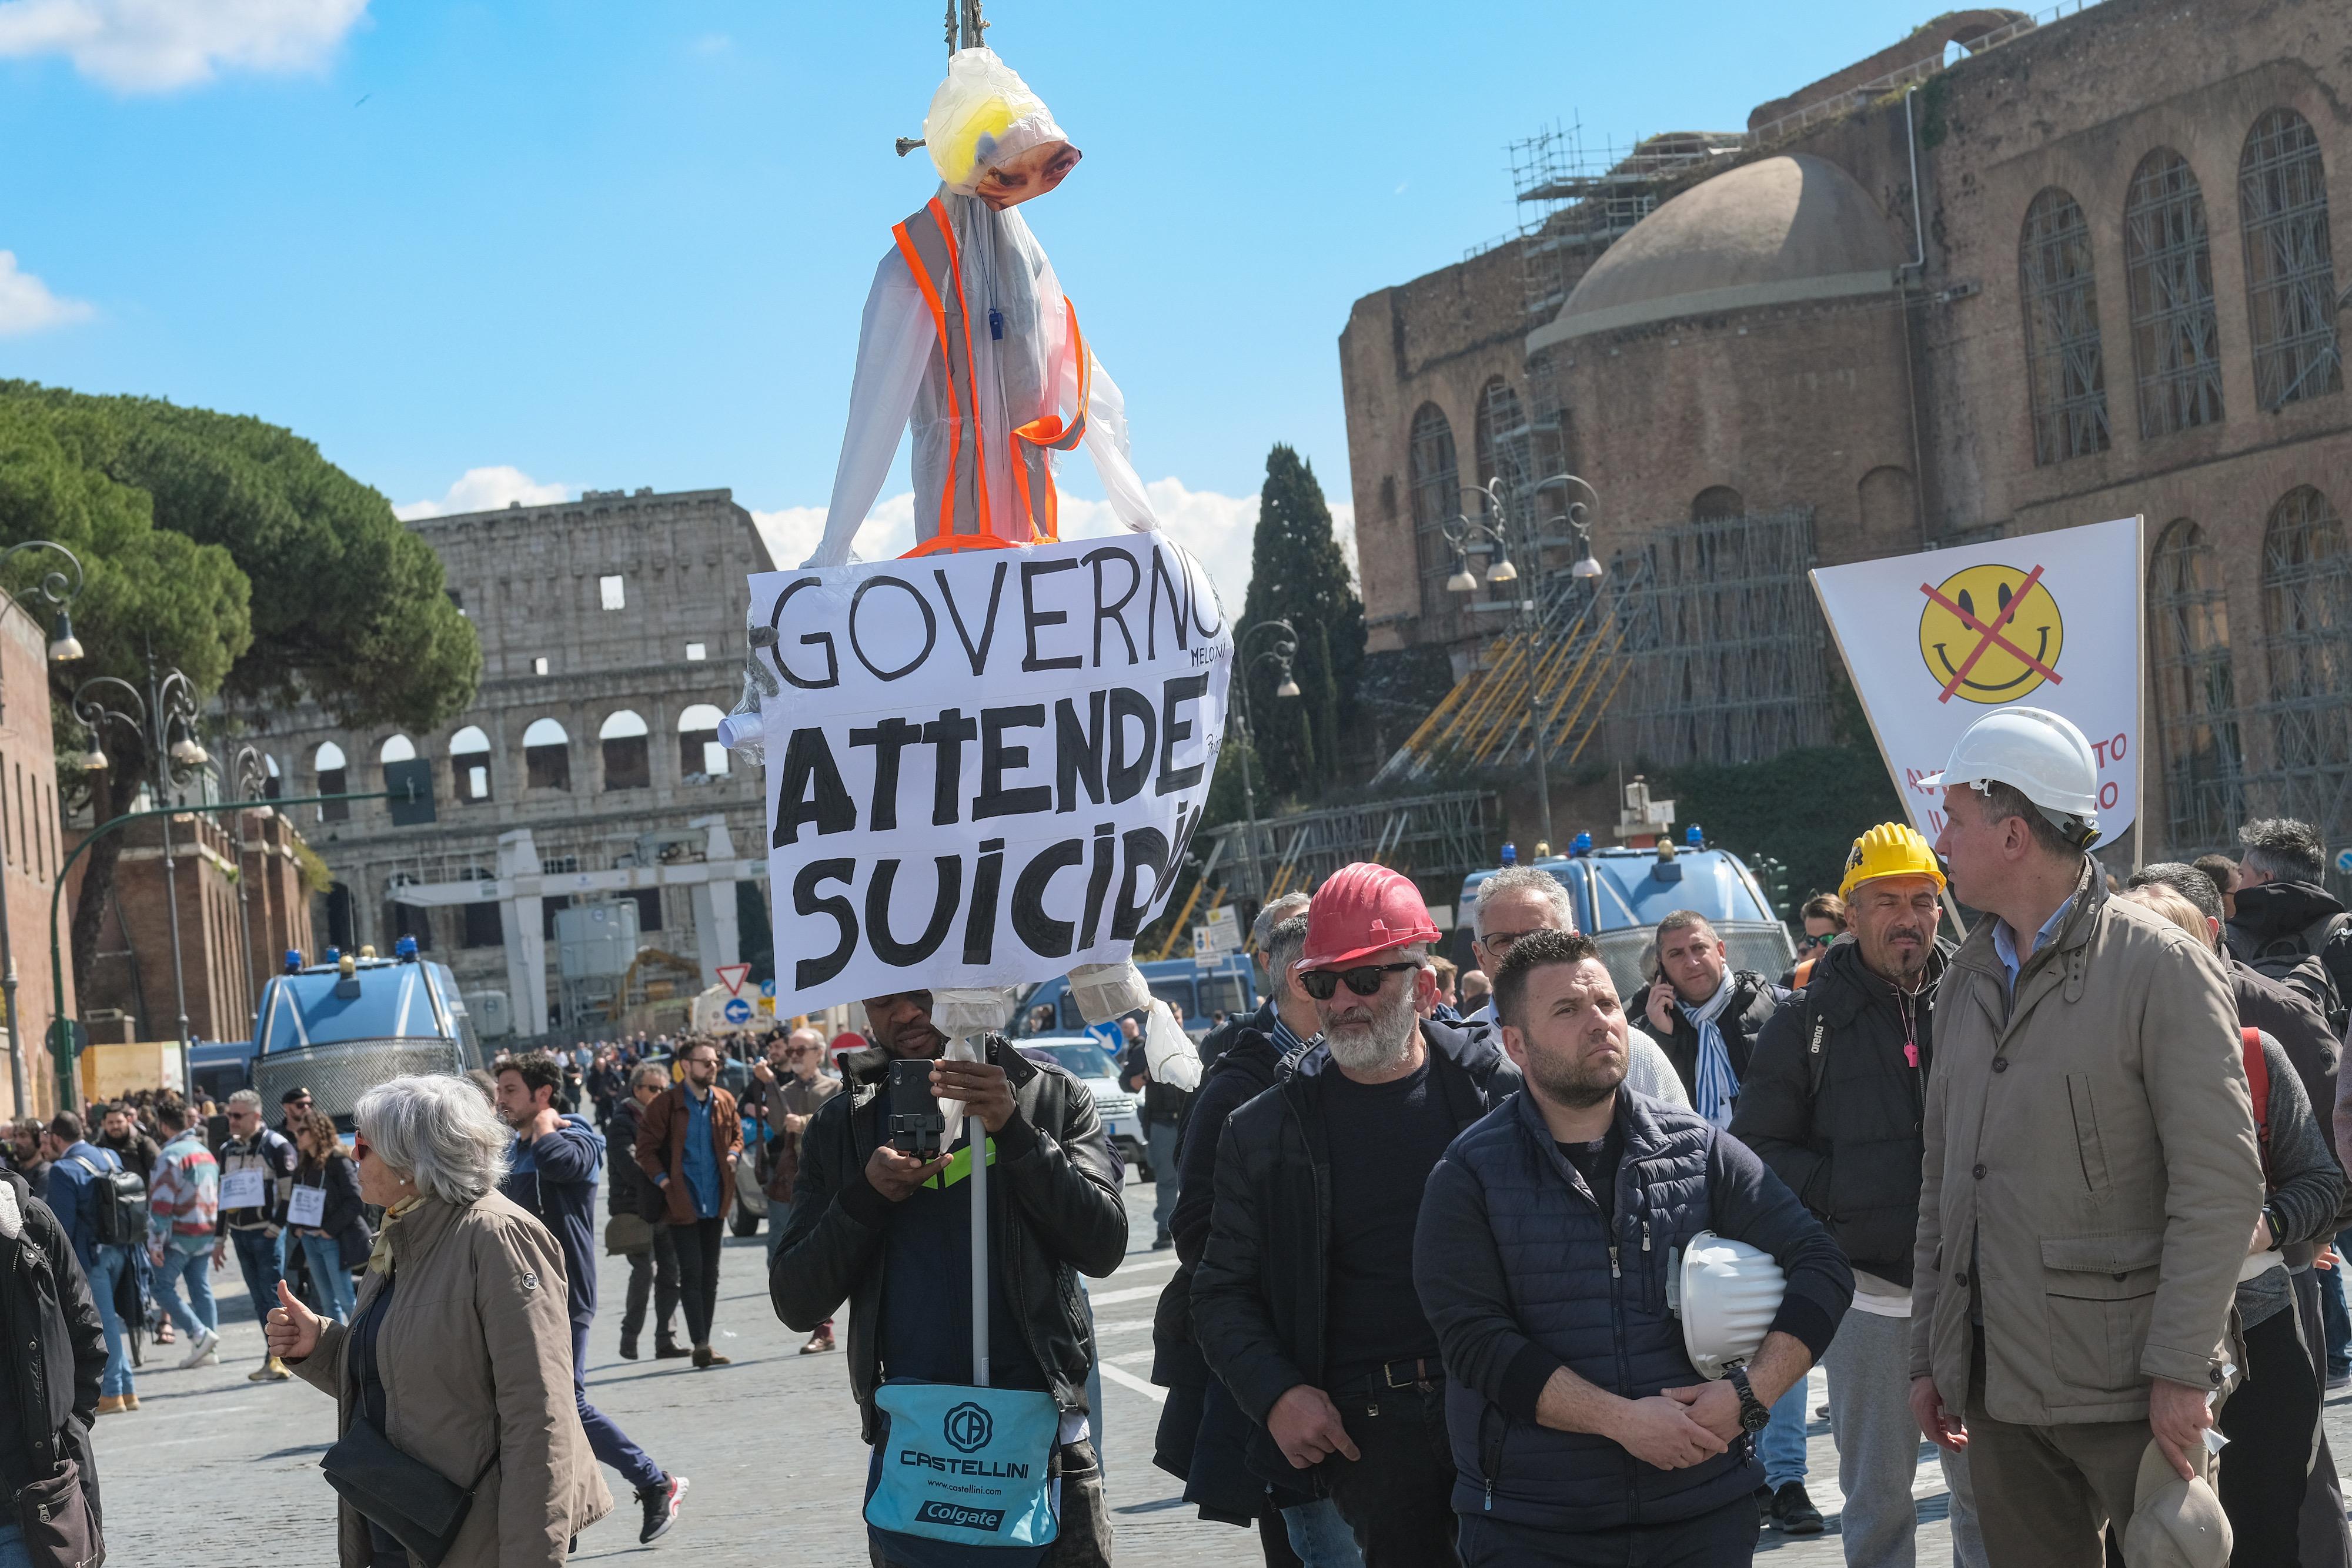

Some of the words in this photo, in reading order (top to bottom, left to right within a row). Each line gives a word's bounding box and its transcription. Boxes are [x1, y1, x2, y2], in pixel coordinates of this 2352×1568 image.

[770, 541, 1222, 689] GOVERNO
[772, 671, 1210, 849] ATTENDE
[1810, 1025, 1824, 1054] arena
[900, 1450, 1029, 1479] CASTELLINI
[927, 1479, 1002, 1496] www.castellini.com
[927, 1503, 998, 1527] Colgate
